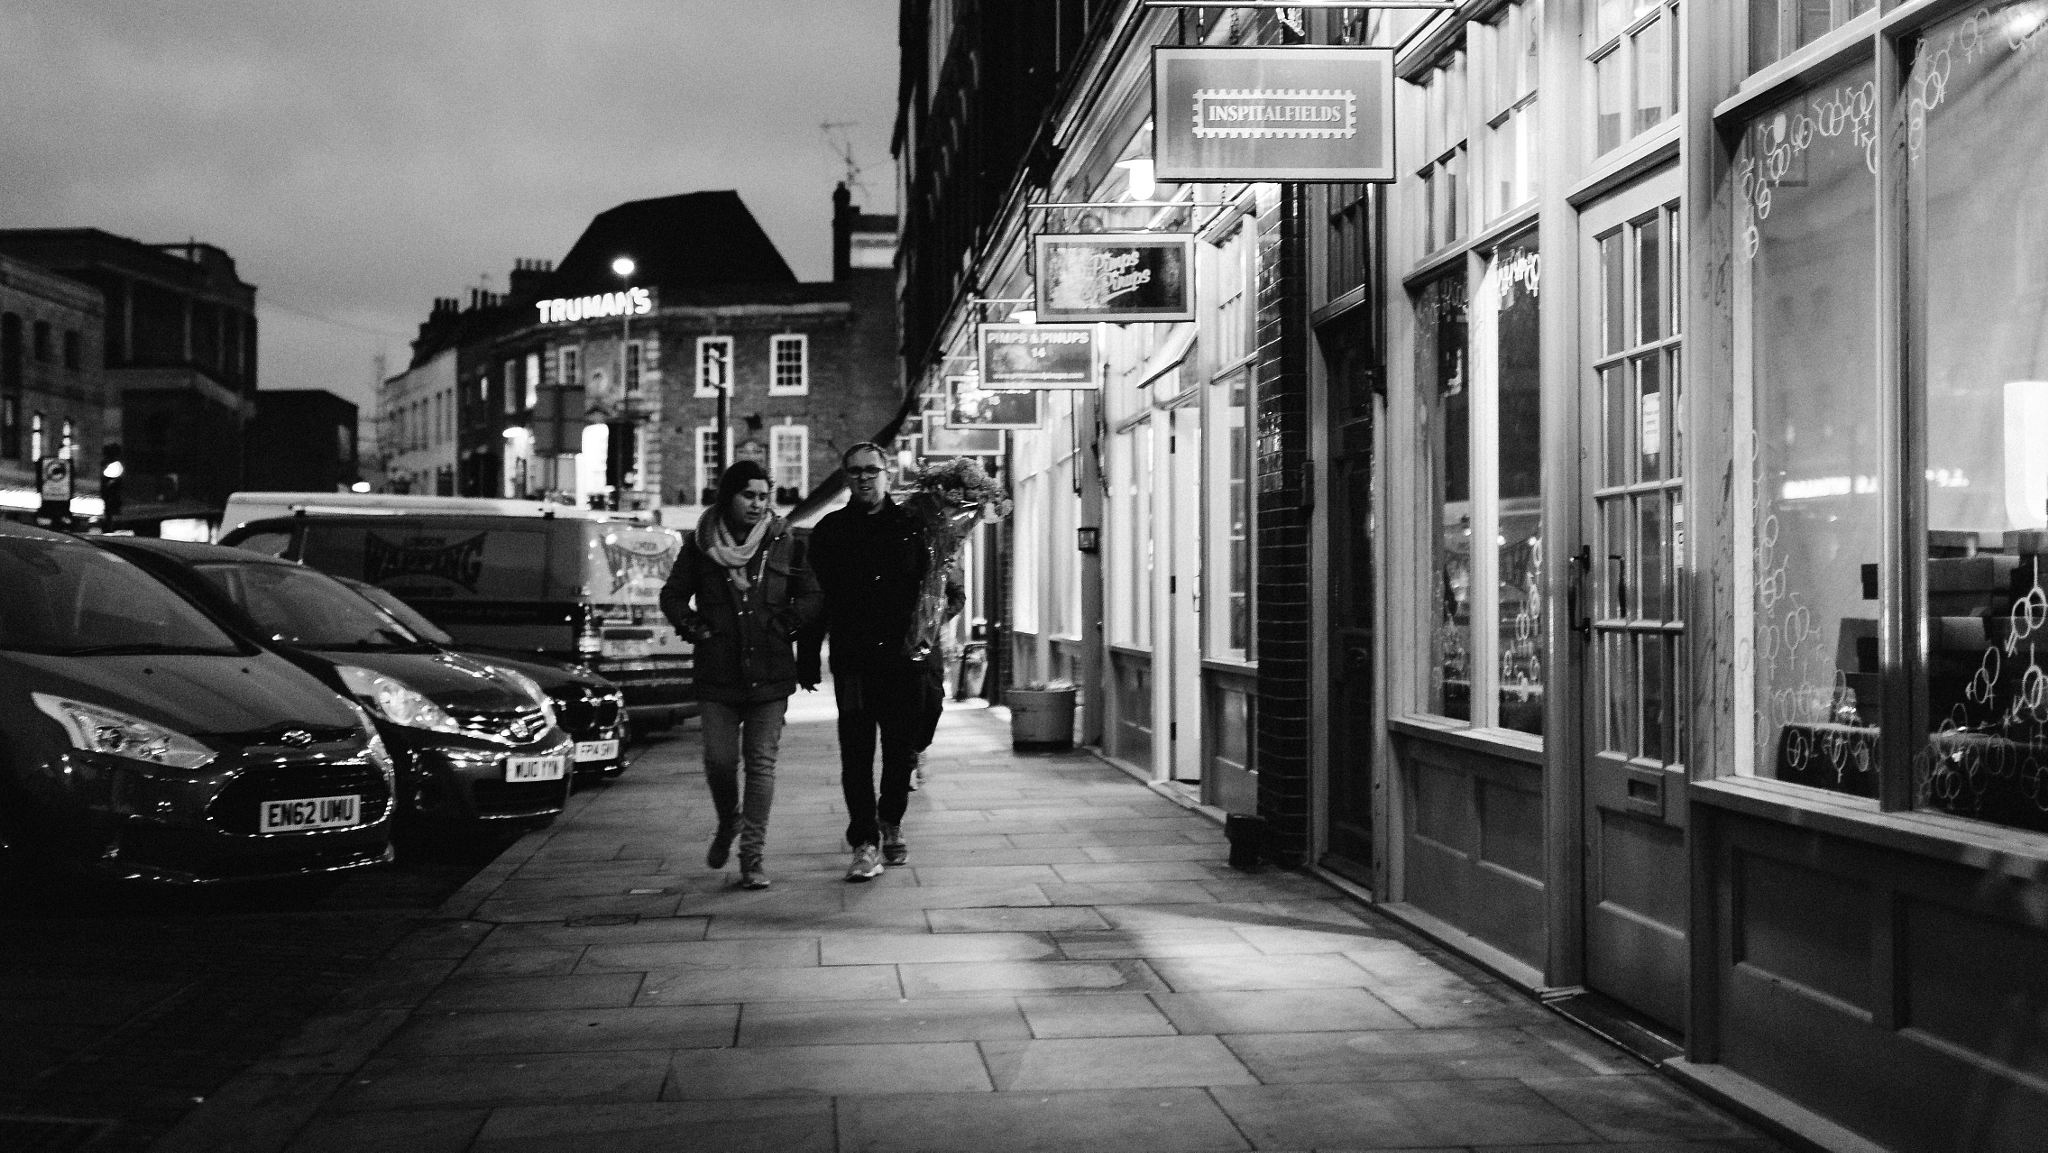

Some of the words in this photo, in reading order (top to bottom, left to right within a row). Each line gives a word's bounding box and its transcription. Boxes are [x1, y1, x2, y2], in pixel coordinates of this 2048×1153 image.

[1208, 105, 1342, 122] INSPITALFIELDS
[535, 286, 652, 324] TRUMAN'S
[987, 331, 1028, 344] PIMPS
[267, 801, 317, 828] EN62
[319, 798, 355, 823] UMU
